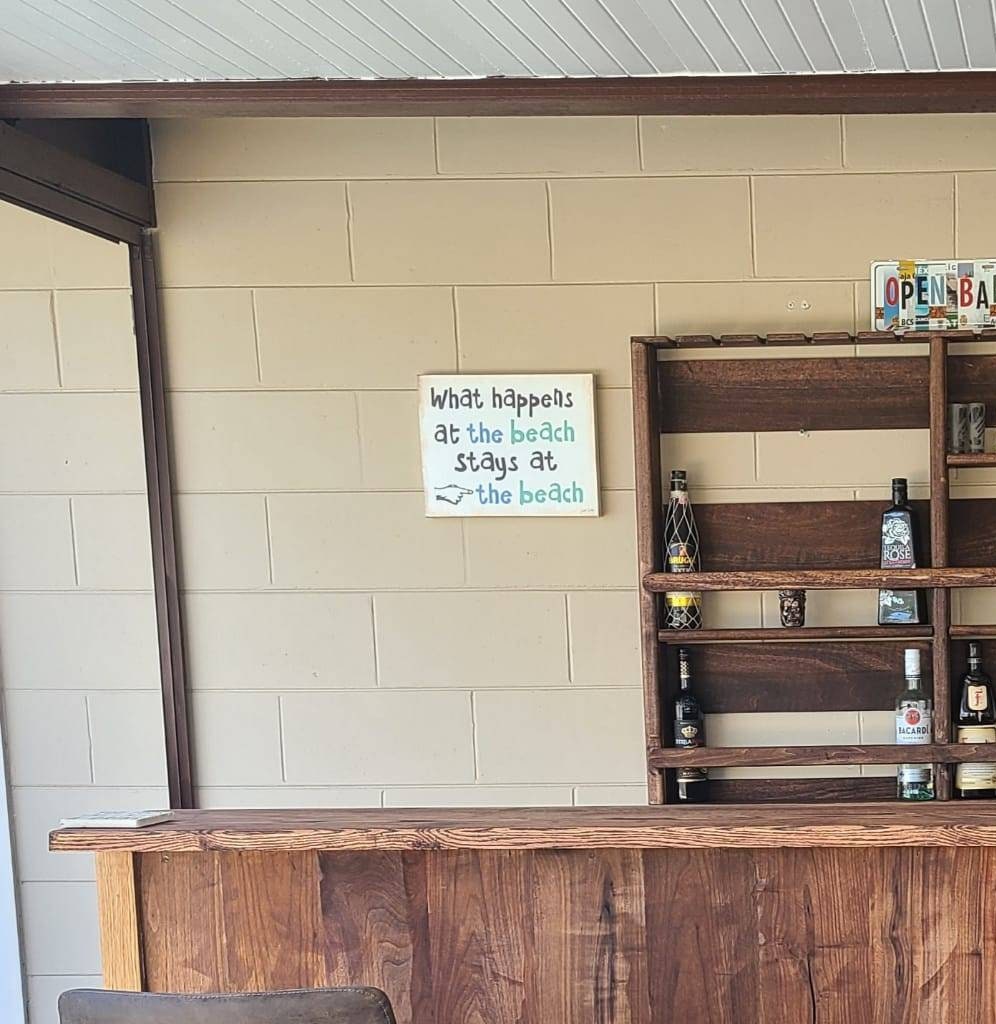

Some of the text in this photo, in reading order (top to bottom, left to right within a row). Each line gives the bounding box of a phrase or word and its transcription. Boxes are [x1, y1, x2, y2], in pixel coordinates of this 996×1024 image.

[885, 274, 946, 310] OPEN
[430, 386, 574, 418] What happens
[434, 419, 575, 445] at the beach
[454, 450, 558, 481] stays at
[475, 479, 584, 506] the beach
[883, 550, 912, 561] ROSE
